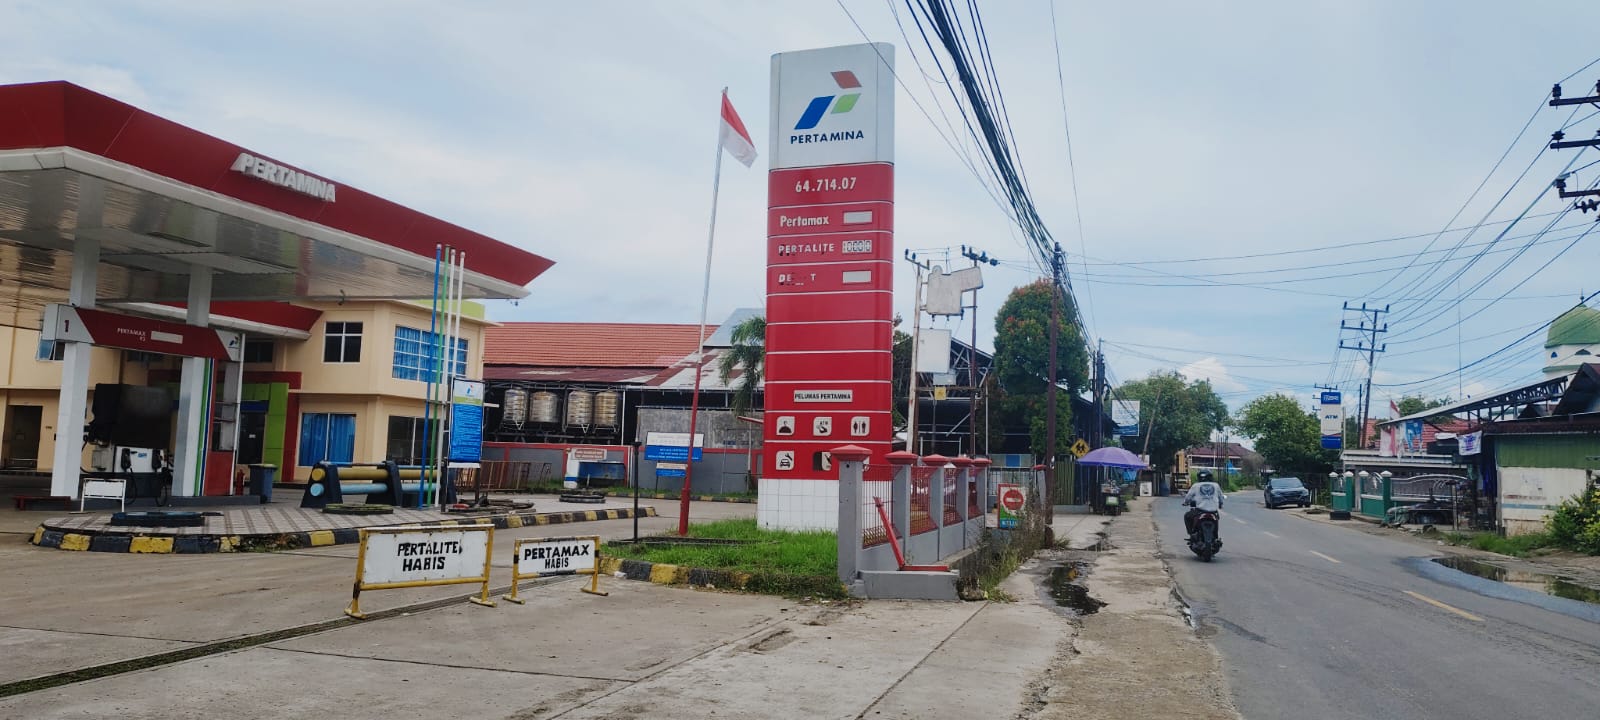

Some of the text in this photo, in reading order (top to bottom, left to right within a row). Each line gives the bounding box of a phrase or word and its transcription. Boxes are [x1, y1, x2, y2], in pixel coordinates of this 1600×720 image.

[790, 130, 864, 144] PERTAMINA
[231, 152, 336, 203] PERTAMINA
[795, 177, 857, 193] 64.714.07
[780, 215, 829, 227] Pertamax
[778, 243, 835, 254] PERTALITE
[524, 544, 590, 560] PERTAMAX
[402, 557, 446, 572] HABIS
[544, 557, 569, 569] HABIS
